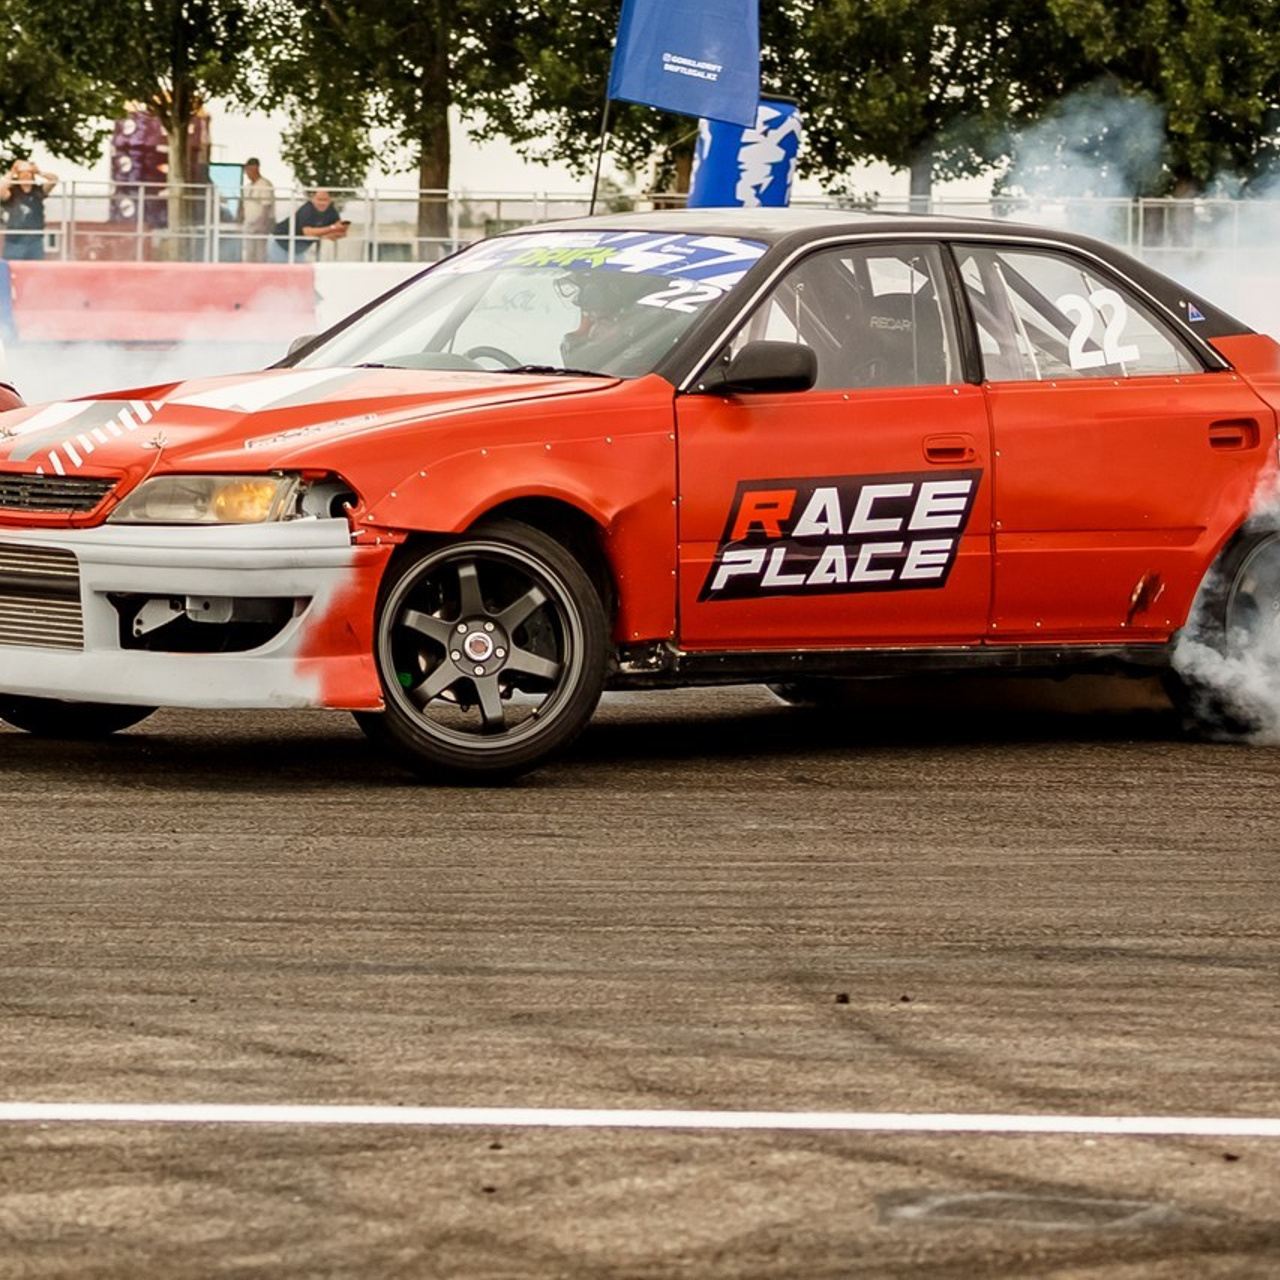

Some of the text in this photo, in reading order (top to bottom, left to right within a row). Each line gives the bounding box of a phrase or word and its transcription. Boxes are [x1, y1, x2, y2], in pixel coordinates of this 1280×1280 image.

[637, 279, 722, 314] 22
[869, 315, 916, 332] RECAR
[1055, 288, 1141, 370] 22
[729, 479, 973, 541] RACE
[710, 538, 954, 590] PLACE
